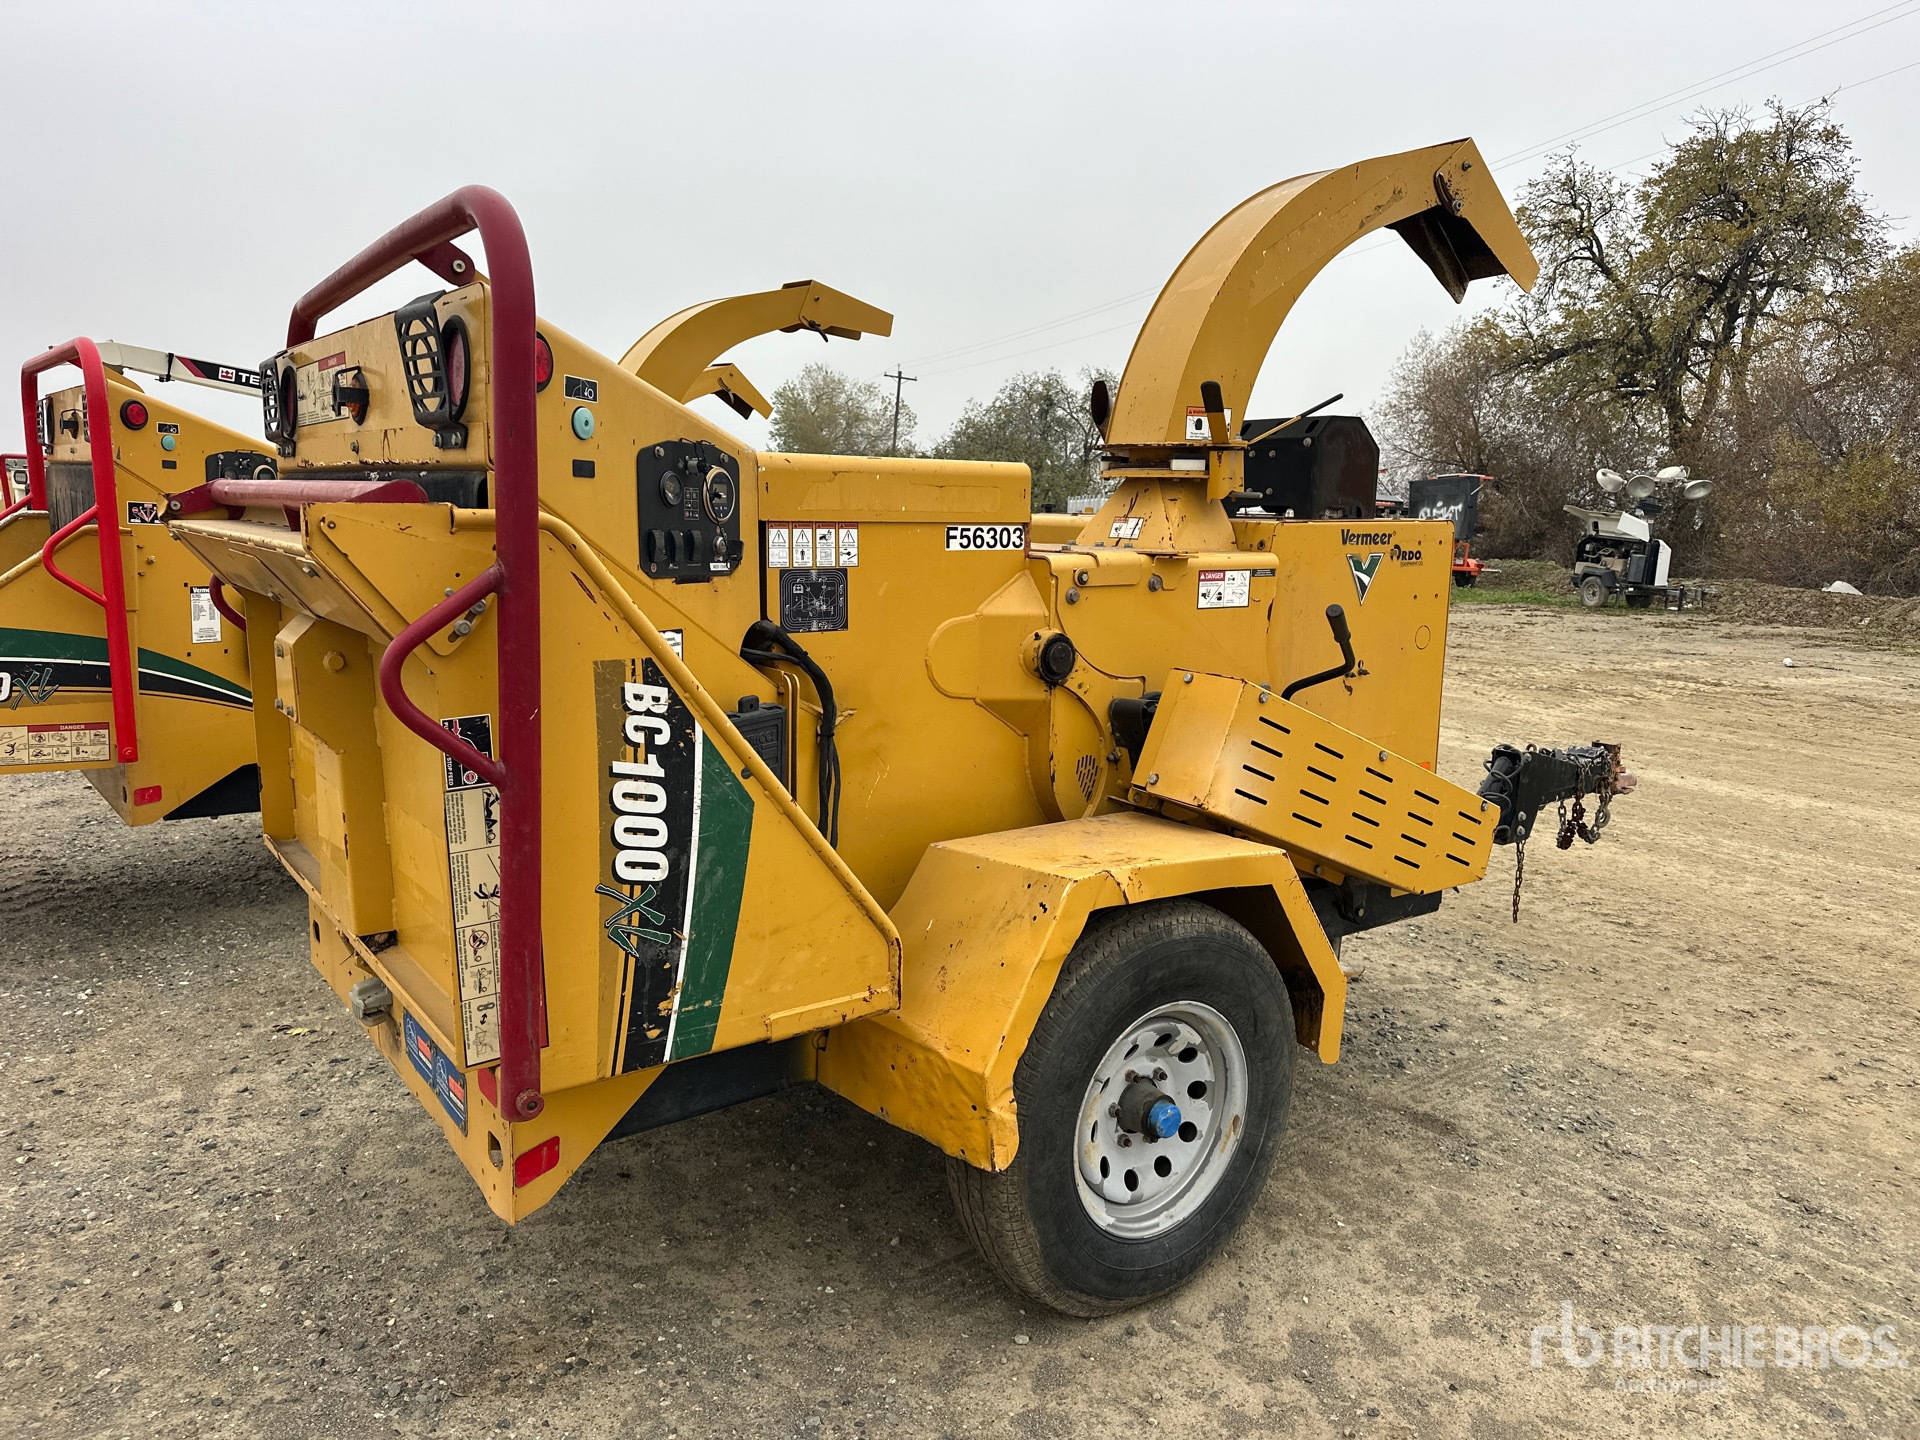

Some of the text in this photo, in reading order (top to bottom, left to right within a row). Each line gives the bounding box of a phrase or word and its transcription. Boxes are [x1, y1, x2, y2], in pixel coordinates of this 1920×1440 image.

[239, 371, 260, 386] TE
[945, 527, 1024, 549] F56303
[1341, 528, 1392, 546] Vermeer
[10, 667, 59, 711] XL
